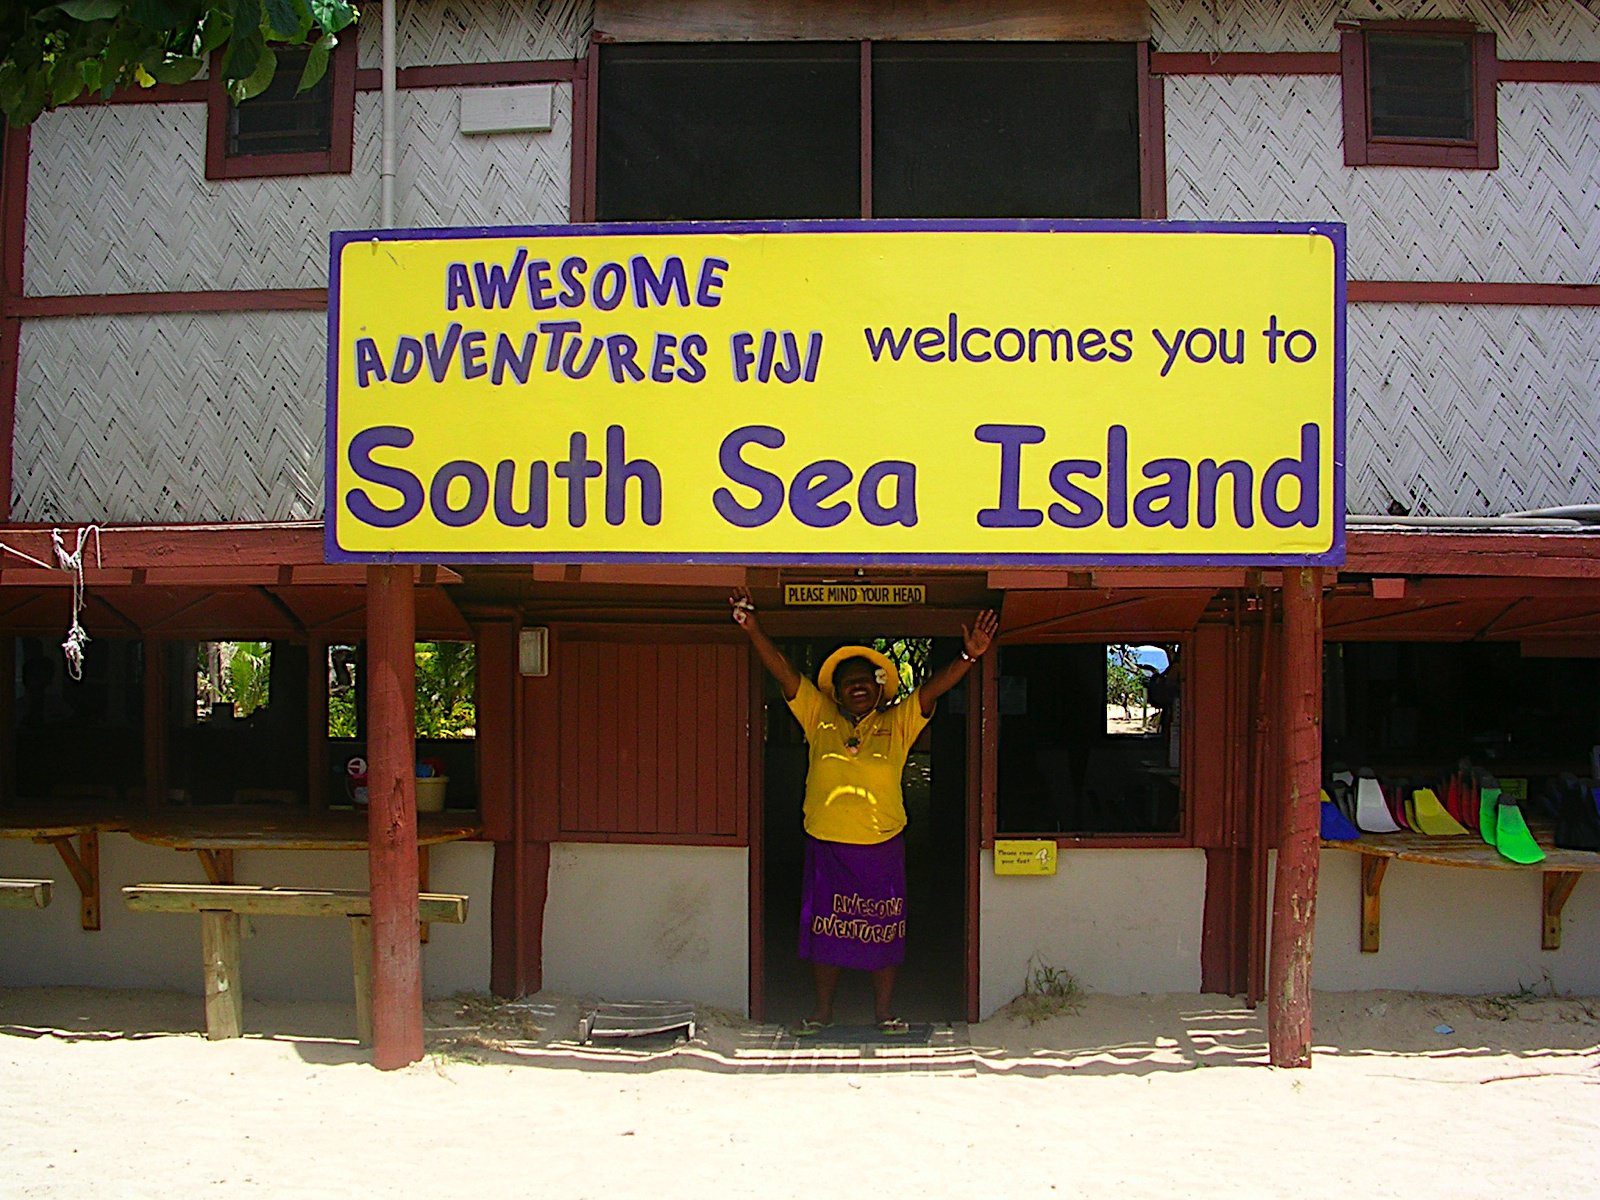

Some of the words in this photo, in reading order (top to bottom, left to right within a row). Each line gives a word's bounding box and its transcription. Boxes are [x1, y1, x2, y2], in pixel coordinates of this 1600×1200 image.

[446, 247, 729, 311] AWESOME
[355, 319, 707, 388] ADVENTURES
[731, 329, 823, 385] FIJI
[865, 314, 1132, 362] welcomes
[1153, 328, 1244, 377] you
[1263, 315, 1317, 363] to
[346, 425, 662, 529] South
[713, 425, 918, 529] Sea
[975, 422, 1320, 529] Island
[788, 587, 824, 602] PLEASE
[828, 587, 857, 602] MIND
[861, 587, 889, 602] YOUR
[893, 587, 922, 602] HEAD
